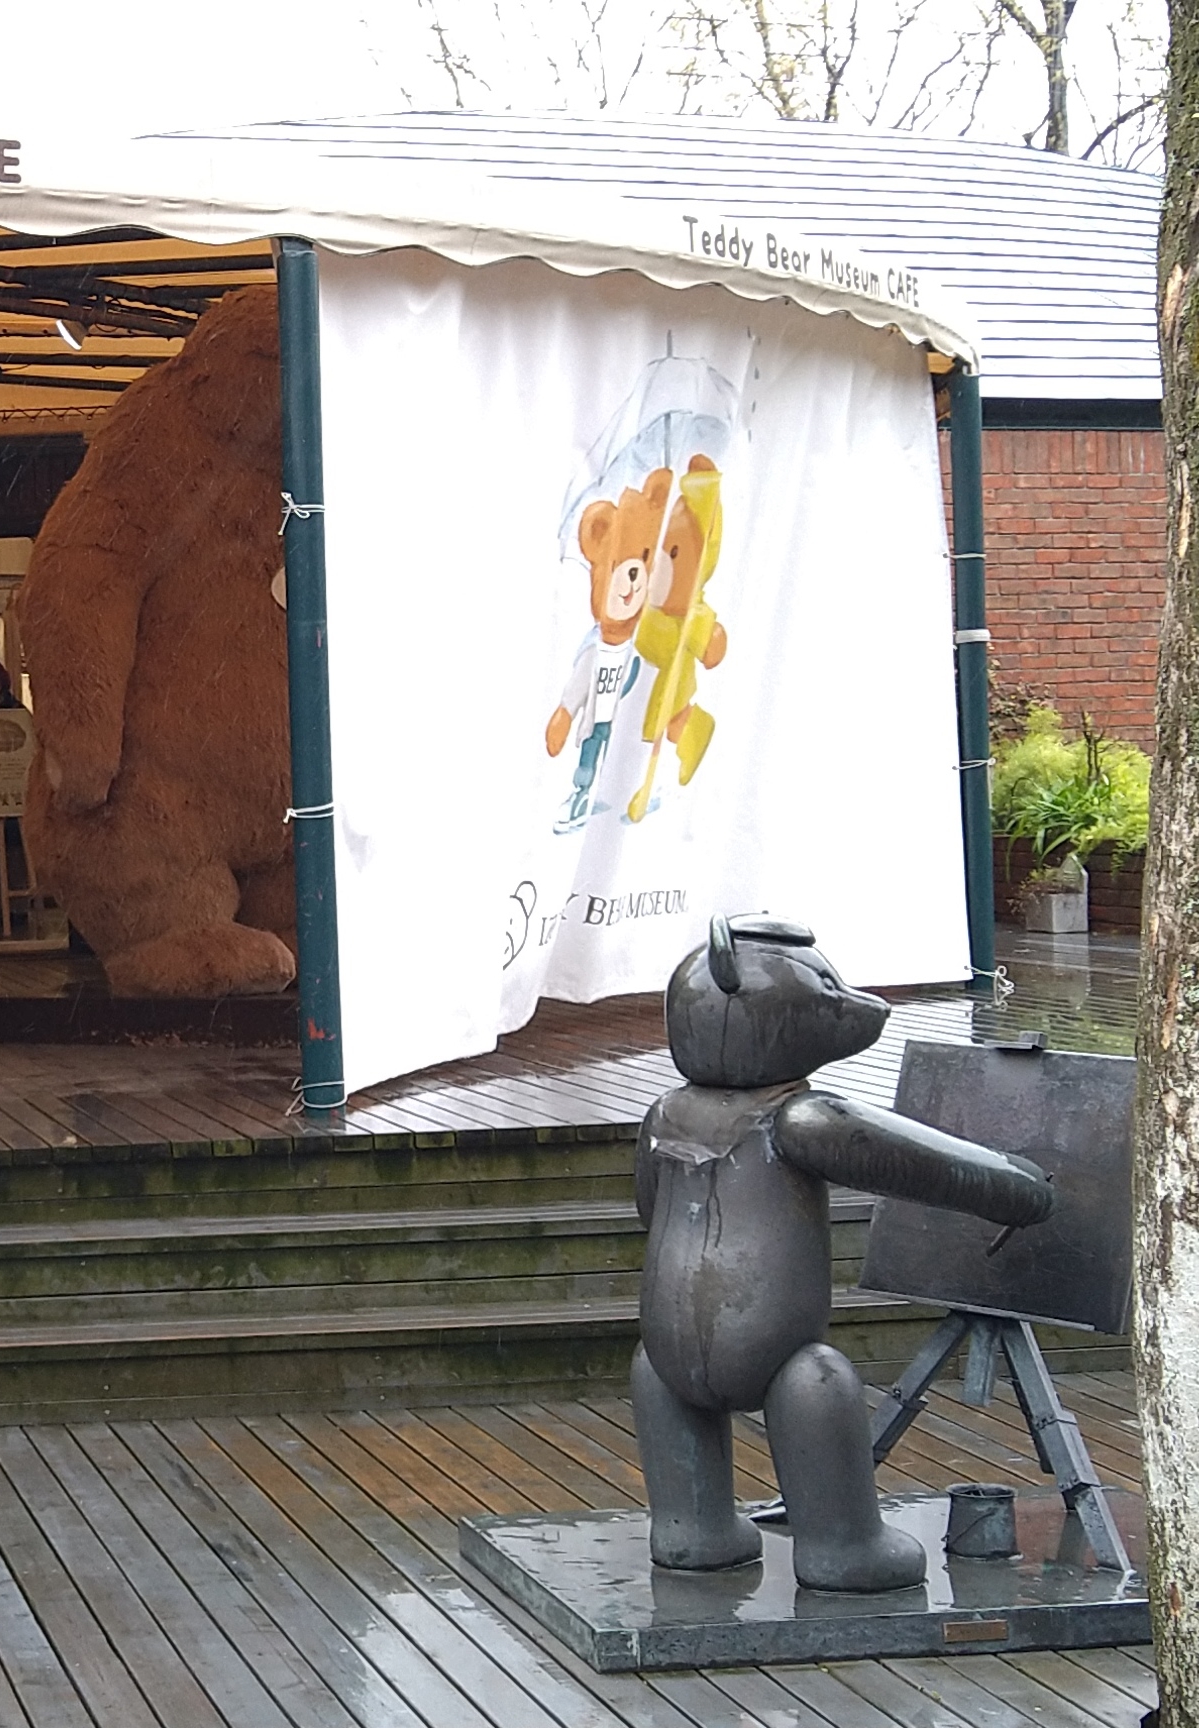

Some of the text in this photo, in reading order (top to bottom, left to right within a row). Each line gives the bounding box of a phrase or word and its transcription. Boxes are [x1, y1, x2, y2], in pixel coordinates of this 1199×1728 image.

[682, 215, 920, 308] Teddy Bear Museum CAFE
